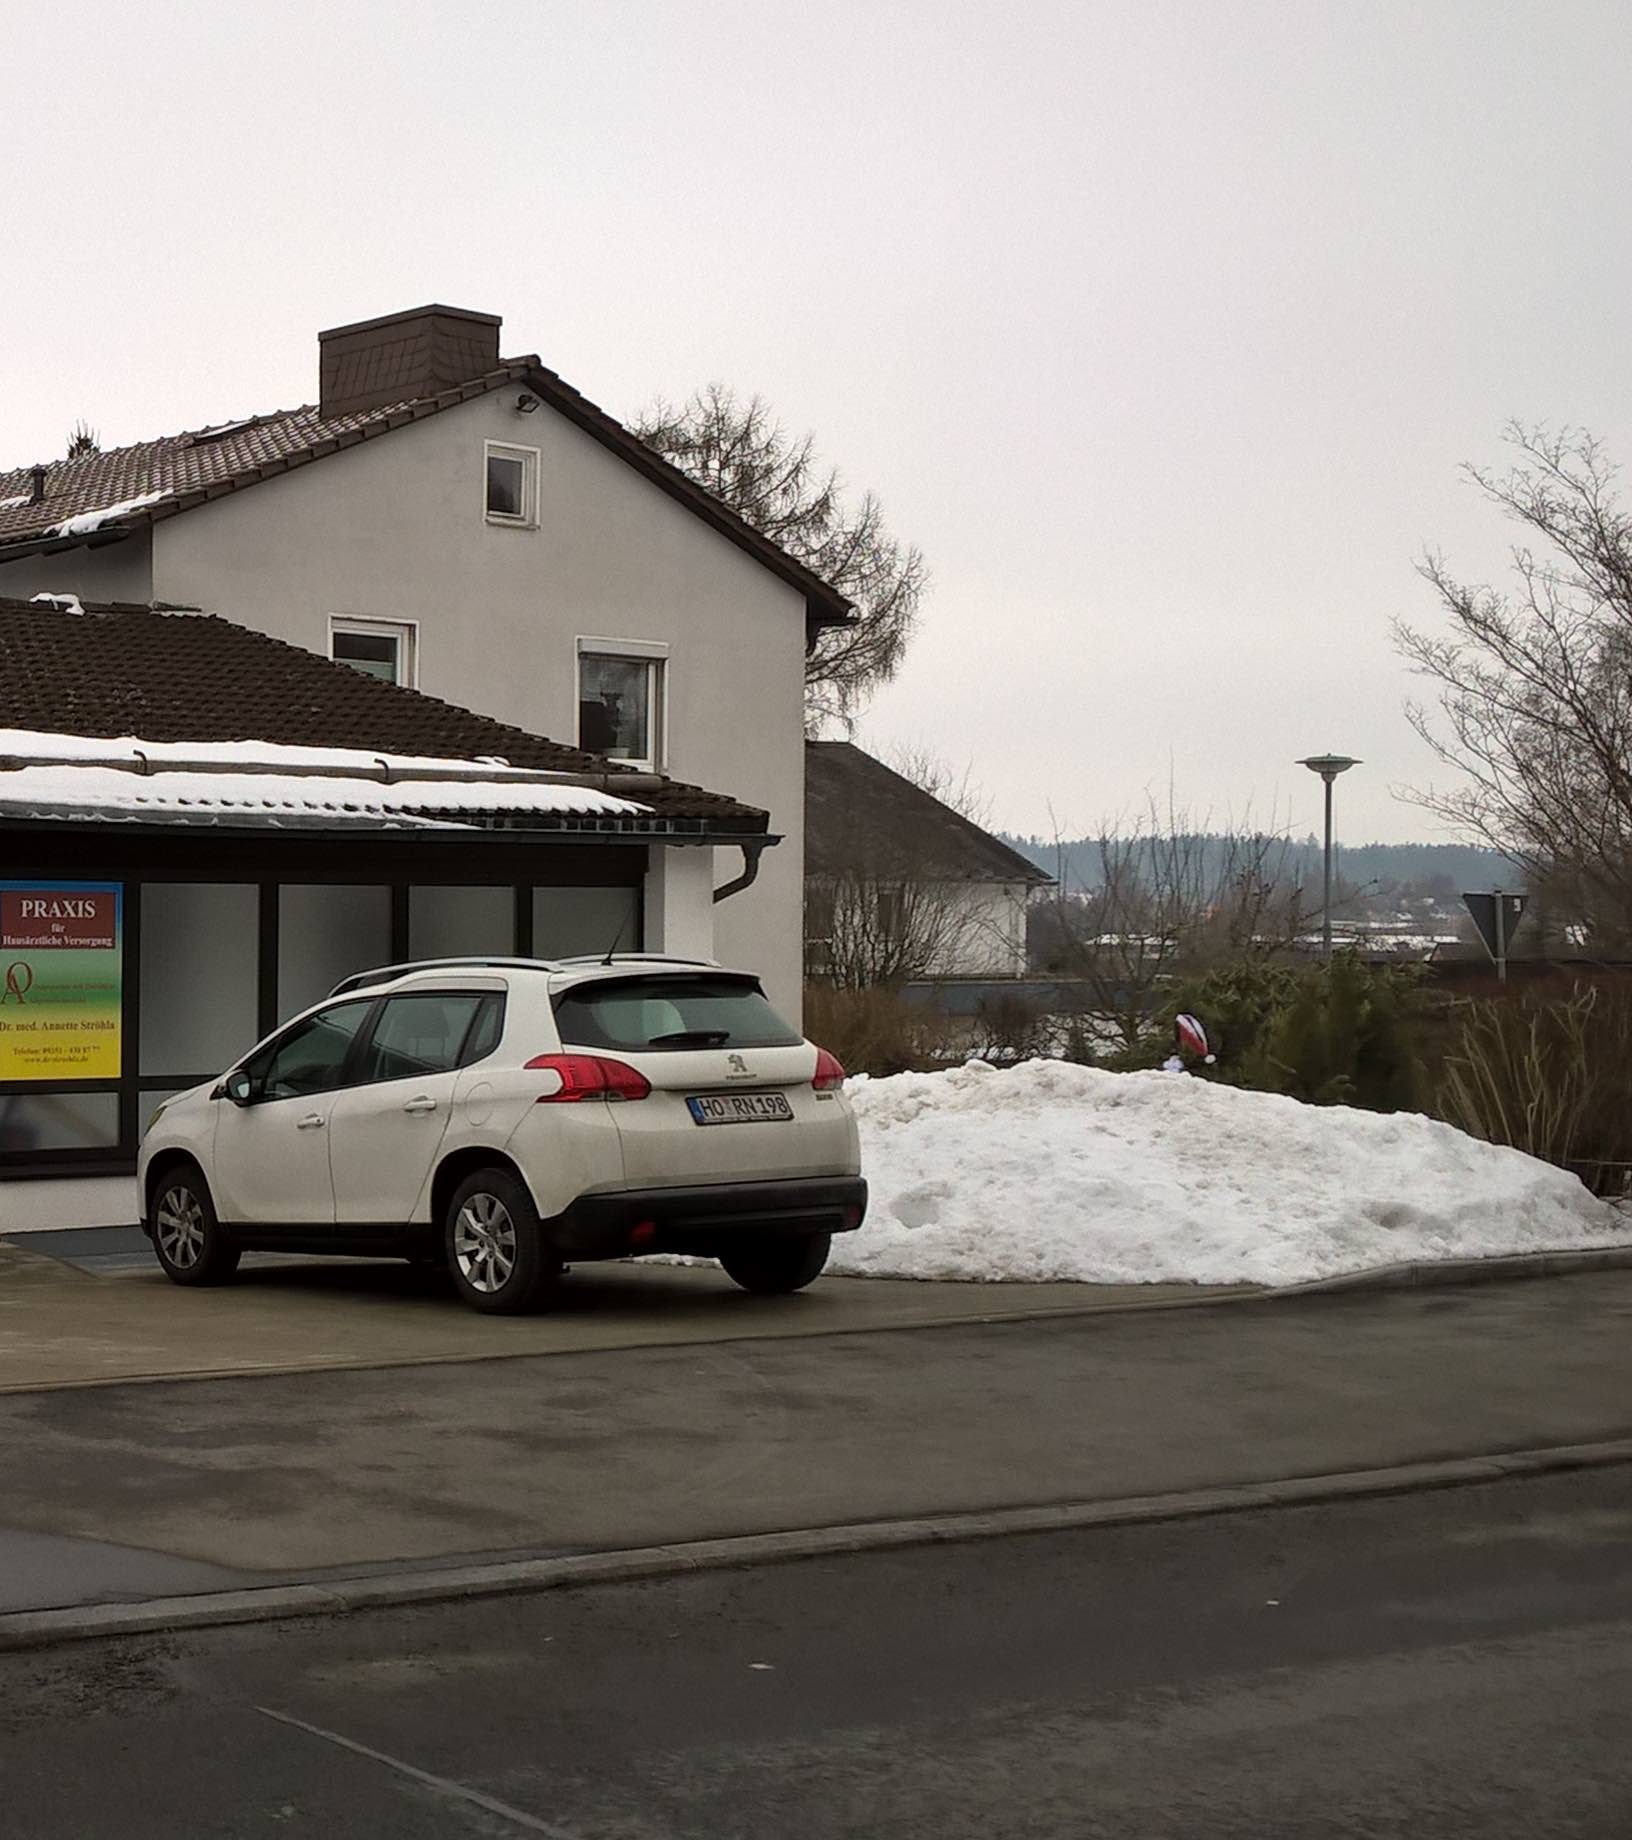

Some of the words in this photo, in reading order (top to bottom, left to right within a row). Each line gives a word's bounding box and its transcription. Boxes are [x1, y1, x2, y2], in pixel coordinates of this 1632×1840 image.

[21, 899, 96, 918] PRAXIS
[51, 922, 65, 933] für
[2, 935, 62, 946] Hausärztliche
[64, 935, 113, 948] Versorgung
[16, 1021, 39, 1032] med.
[41, 1021, 78, 1031] Annette
[699, 1098, 725, 1117] HO
[732, 1096, 757, 1115] RN
[757, 1095, 788, 1114] 198
